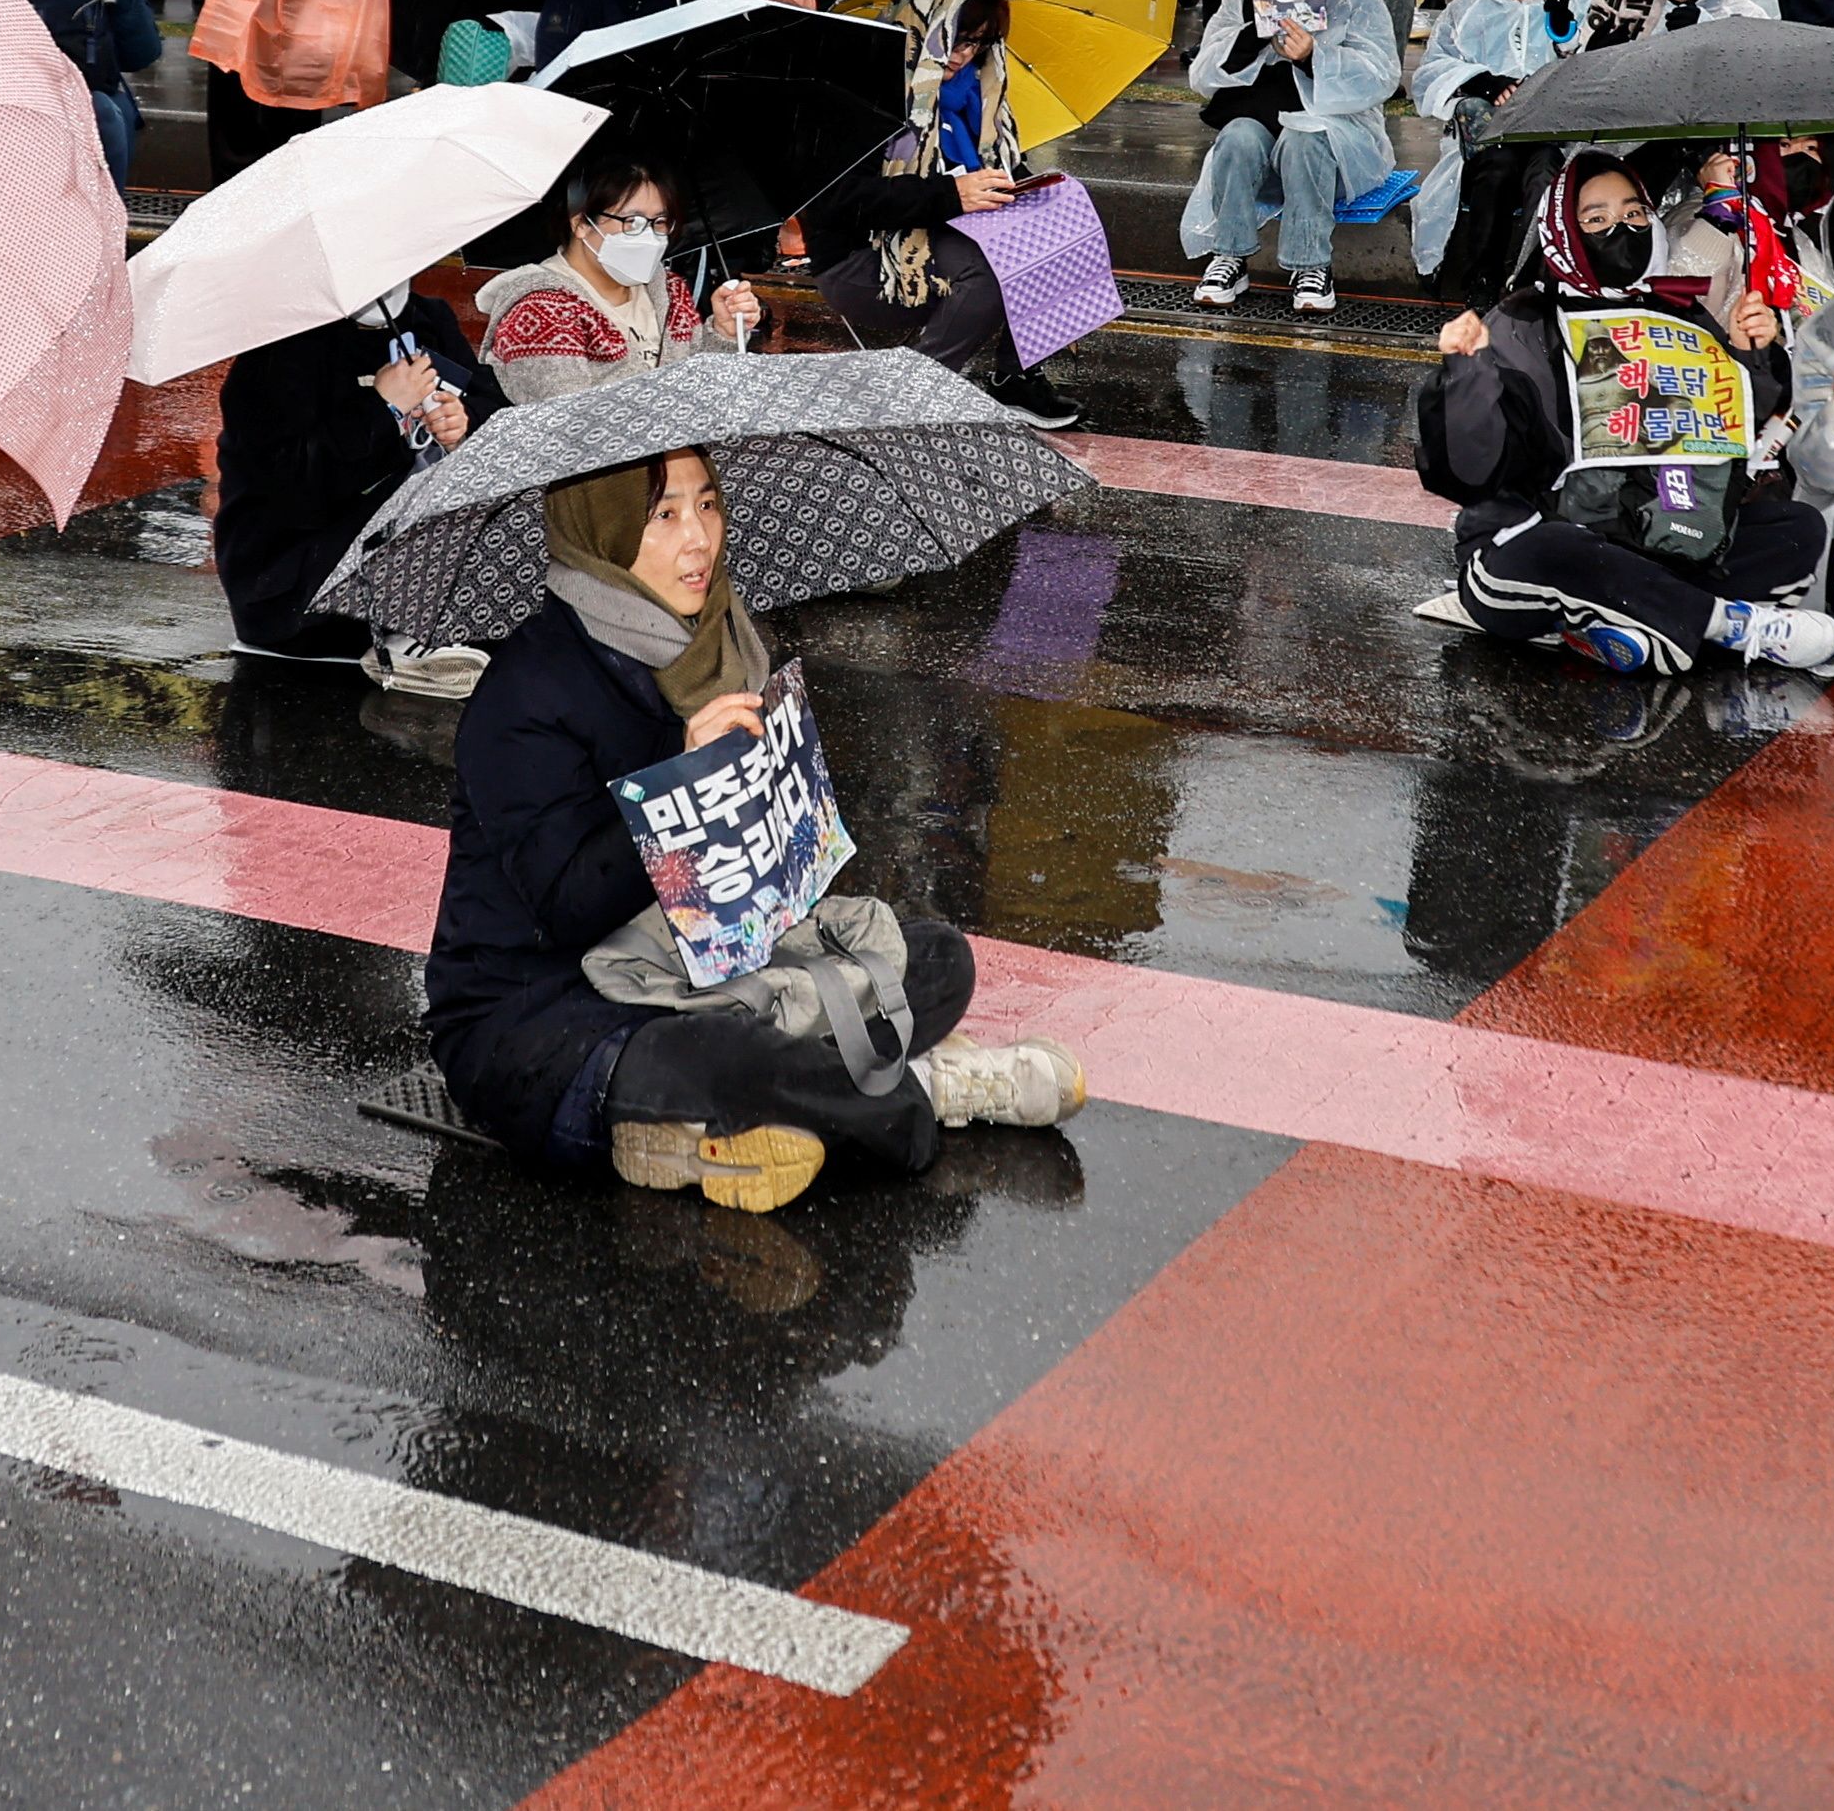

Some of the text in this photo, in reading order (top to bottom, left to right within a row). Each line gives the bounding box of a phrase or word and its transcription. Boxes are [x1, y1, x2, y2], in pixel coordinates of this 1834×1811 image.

[1610, 320, 1704, 355] 탄탄면
[1617, 358, 1709, 399] 핵불닭
[1607, 402, 1729, 447] 해물라면
